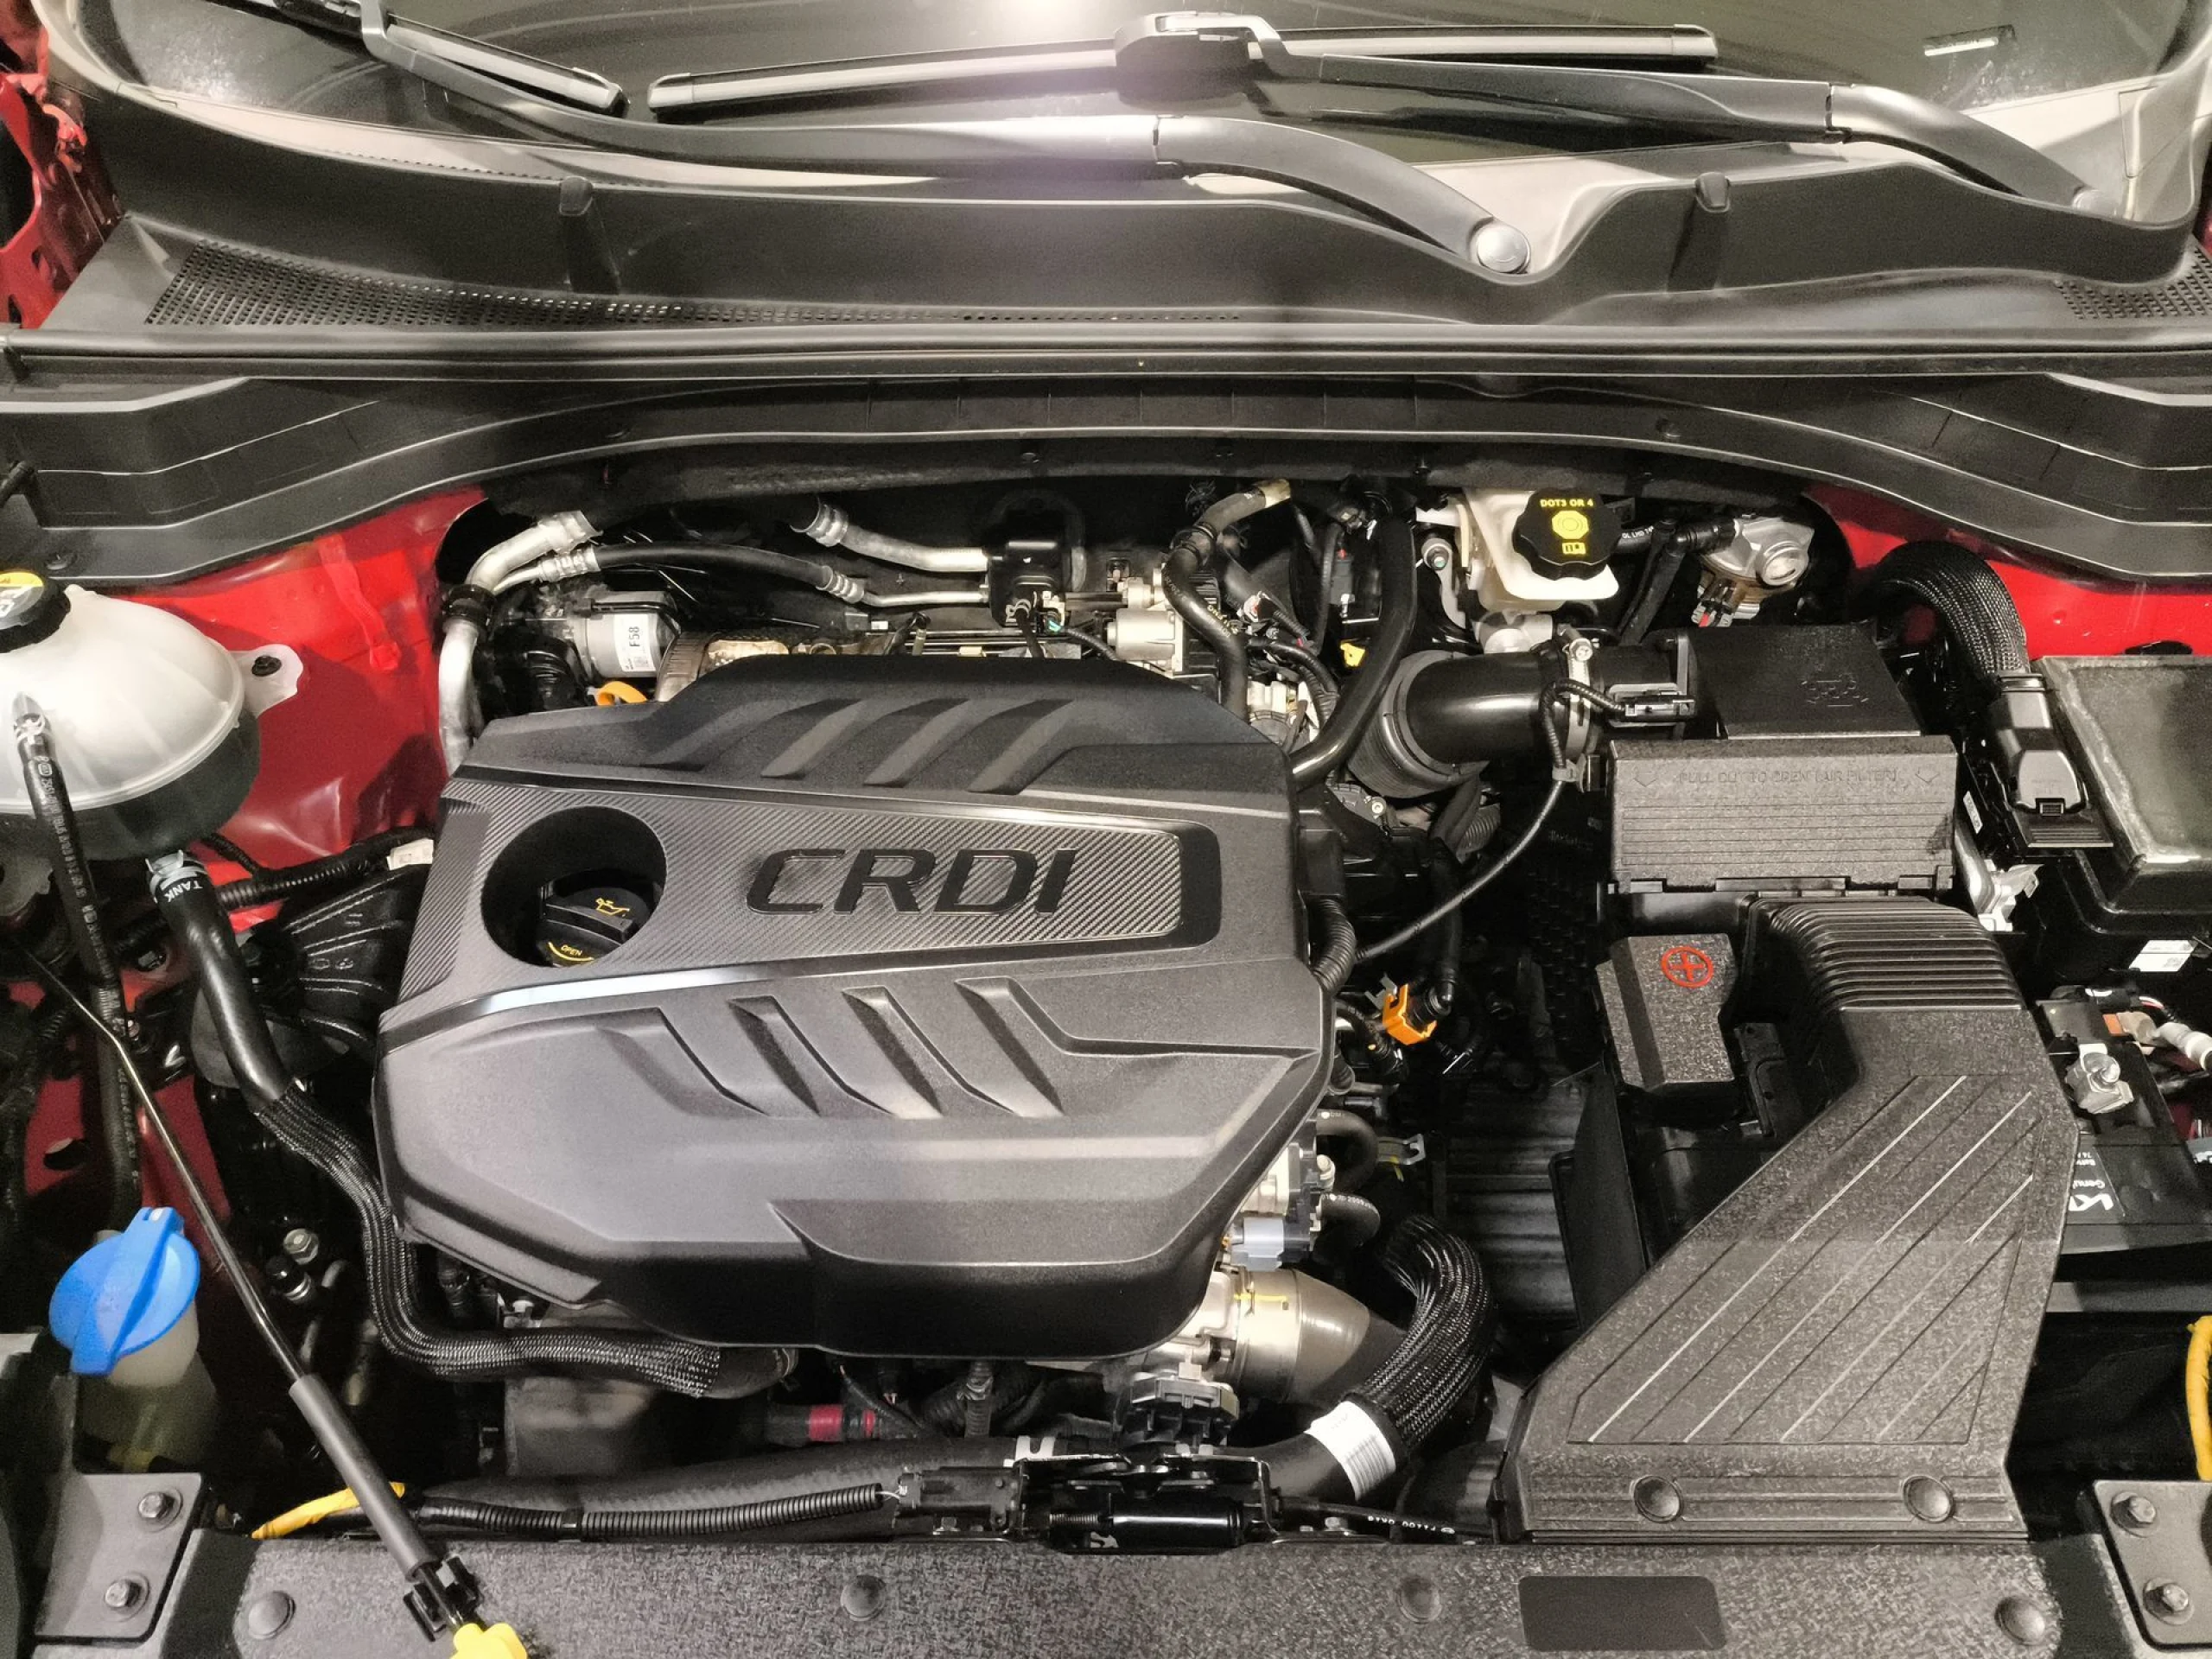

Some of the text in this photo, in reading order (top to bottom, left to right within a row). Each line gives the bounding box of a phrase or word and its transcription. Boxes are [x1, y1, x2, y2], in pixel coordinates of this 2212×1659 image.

[1540, 499, 1594, 507] DOT3 OR 4
[628, 626, 640, 647] F58
[1679, 772, 1713, 784] PULL
[1717, 772, 1745, 784] OUT
[1750, 772, 1768, 784] TO
[1771, 770, 1809, 783] OPEN
[747, 849, 1078, 916] CRDI
[168, 880, 203, 903] TANK
[561, 944, 582, 956] OPEN
